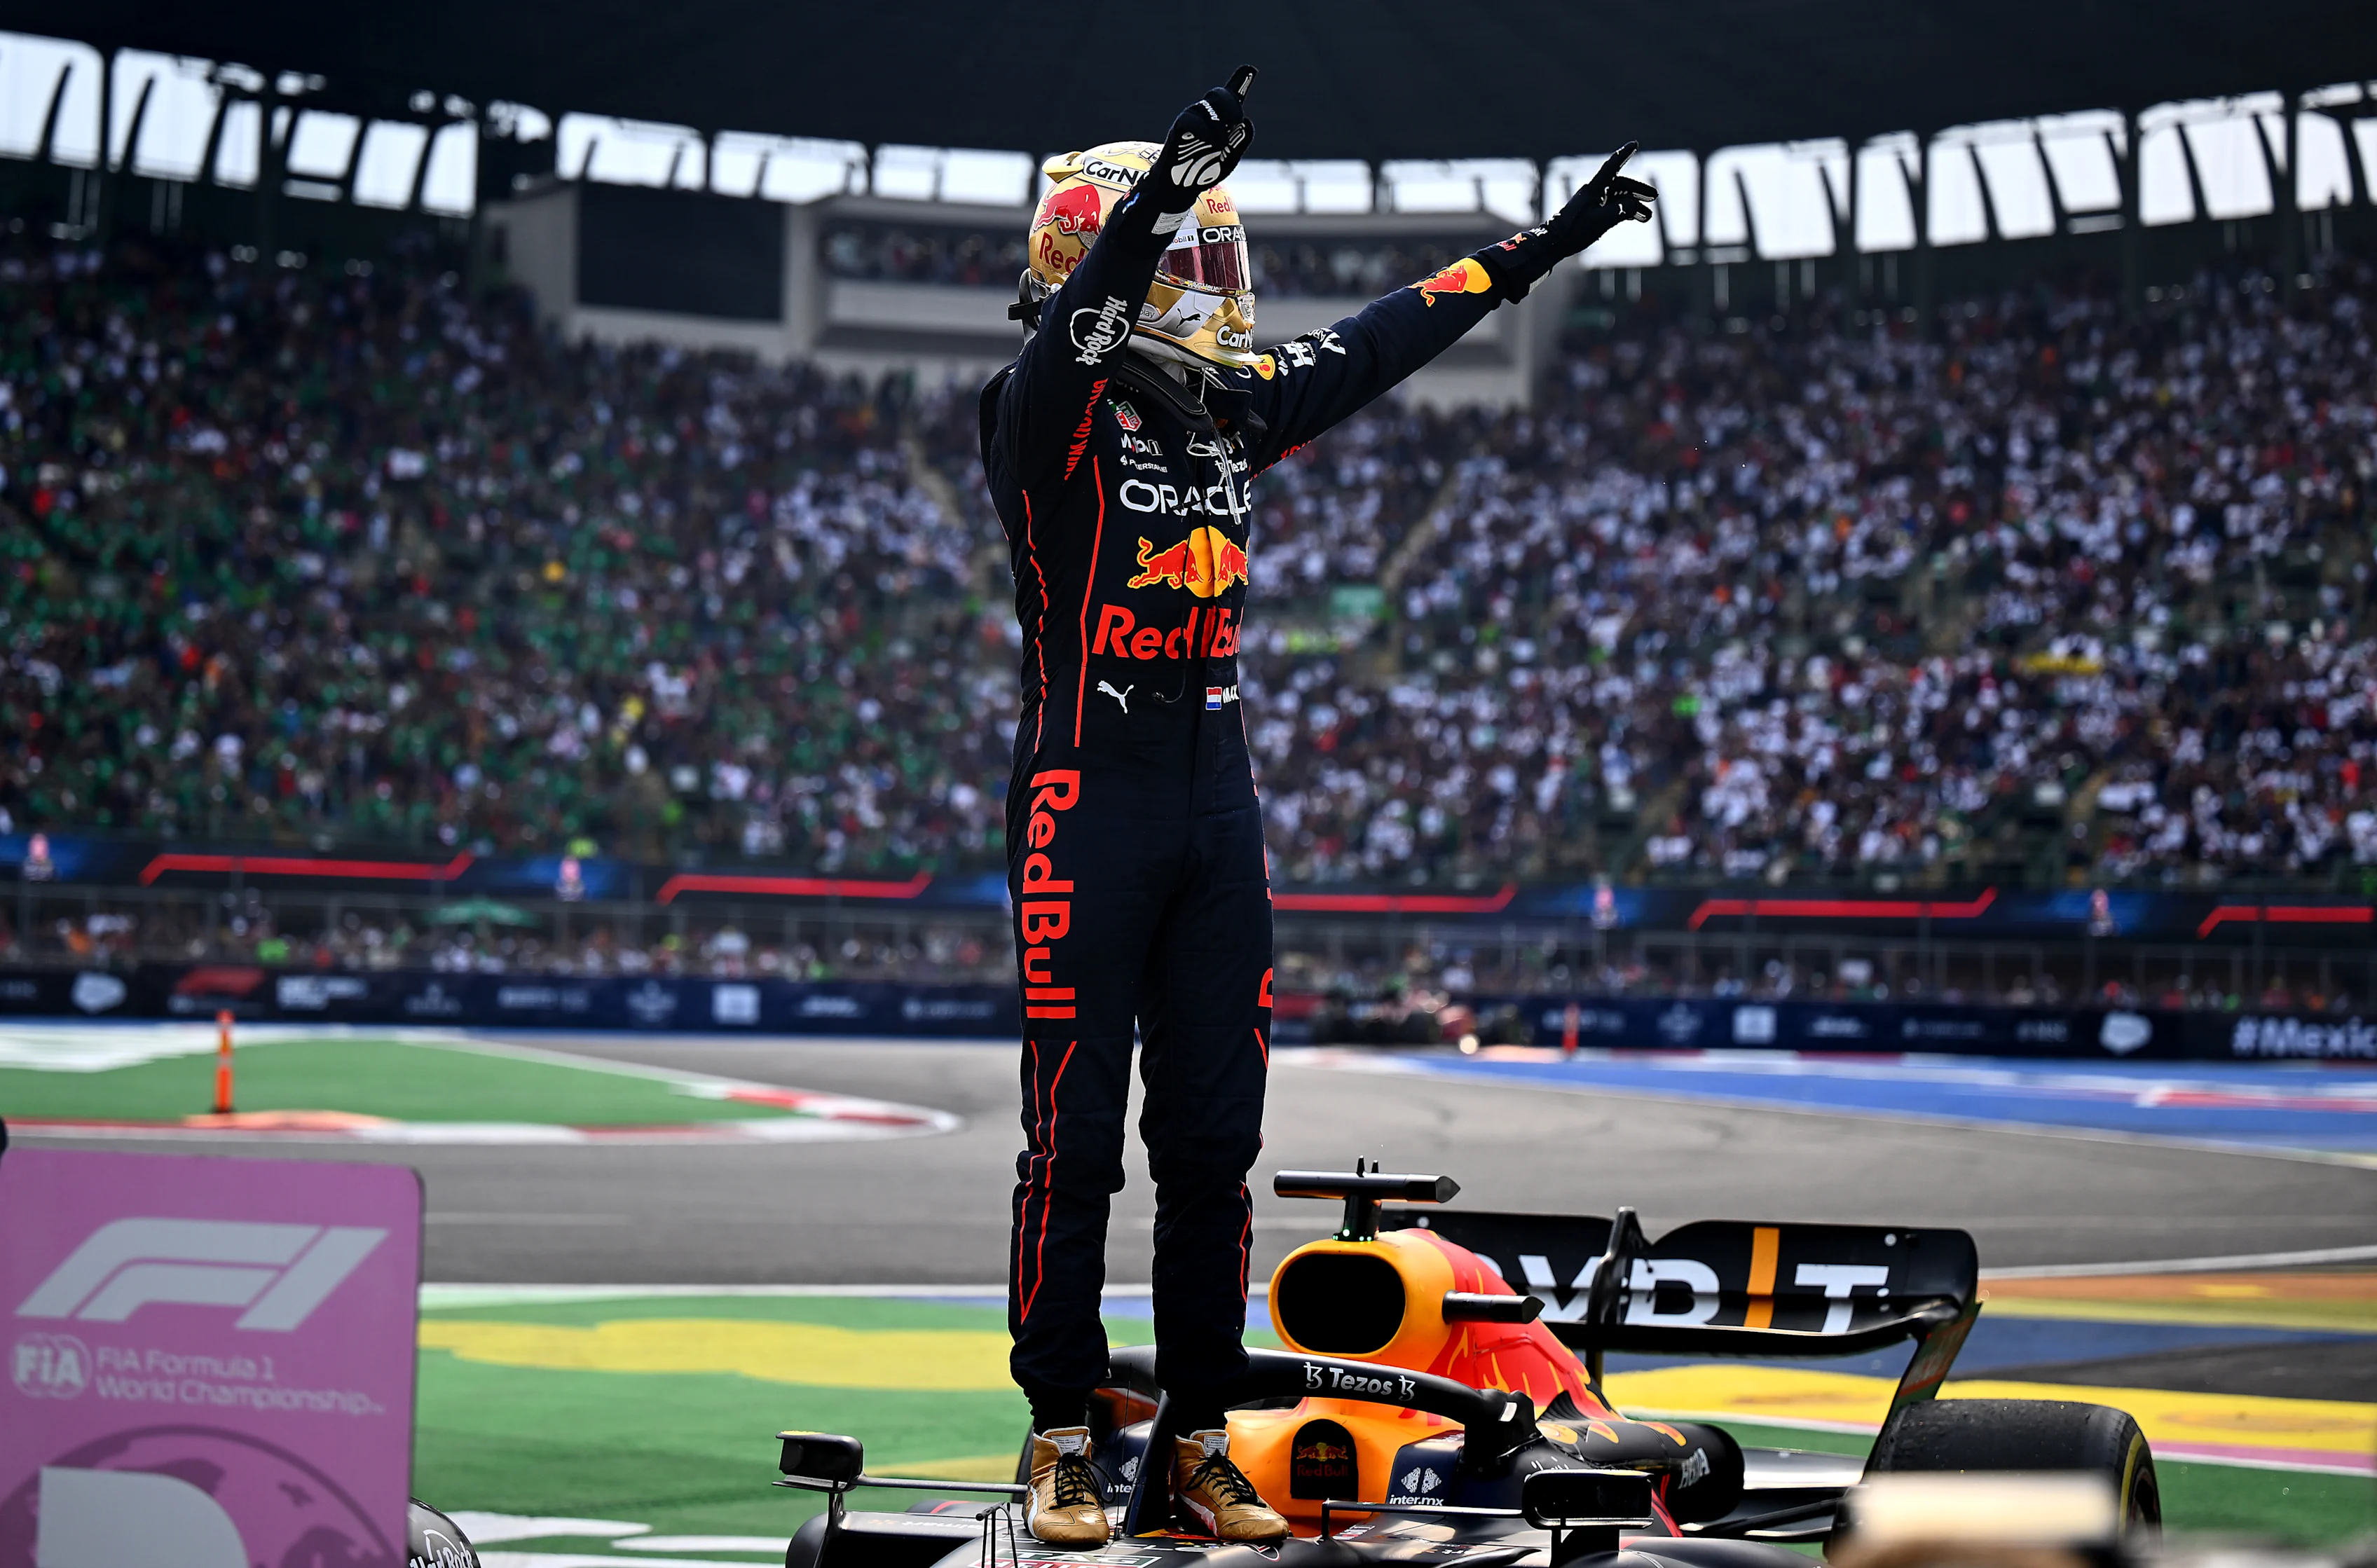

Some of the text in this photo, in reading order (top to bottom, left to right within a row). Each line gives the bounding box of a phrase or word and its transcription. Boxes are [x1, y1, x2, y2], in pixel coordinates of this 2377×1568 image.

[1085, 160, 1139, 185] CarN
[1171, 235, 1186, 244] obil
[1075, 331, 1113, 366] Rock
[1216, 325, 1253, 349] CarN
[1222, 684, 1240, 704] MAX
[1474, 1227, 1890, 1335] YBIT
[96, 1346, 275, 1381] FIA Formula 1
[95, 1374, 175, 1401] World
[1329, 1366, 1393, 1396] Tezos
[1389, 1494, 1444, 1507] inter.mx
[1008, 1550, 1141, 1565] TAG
